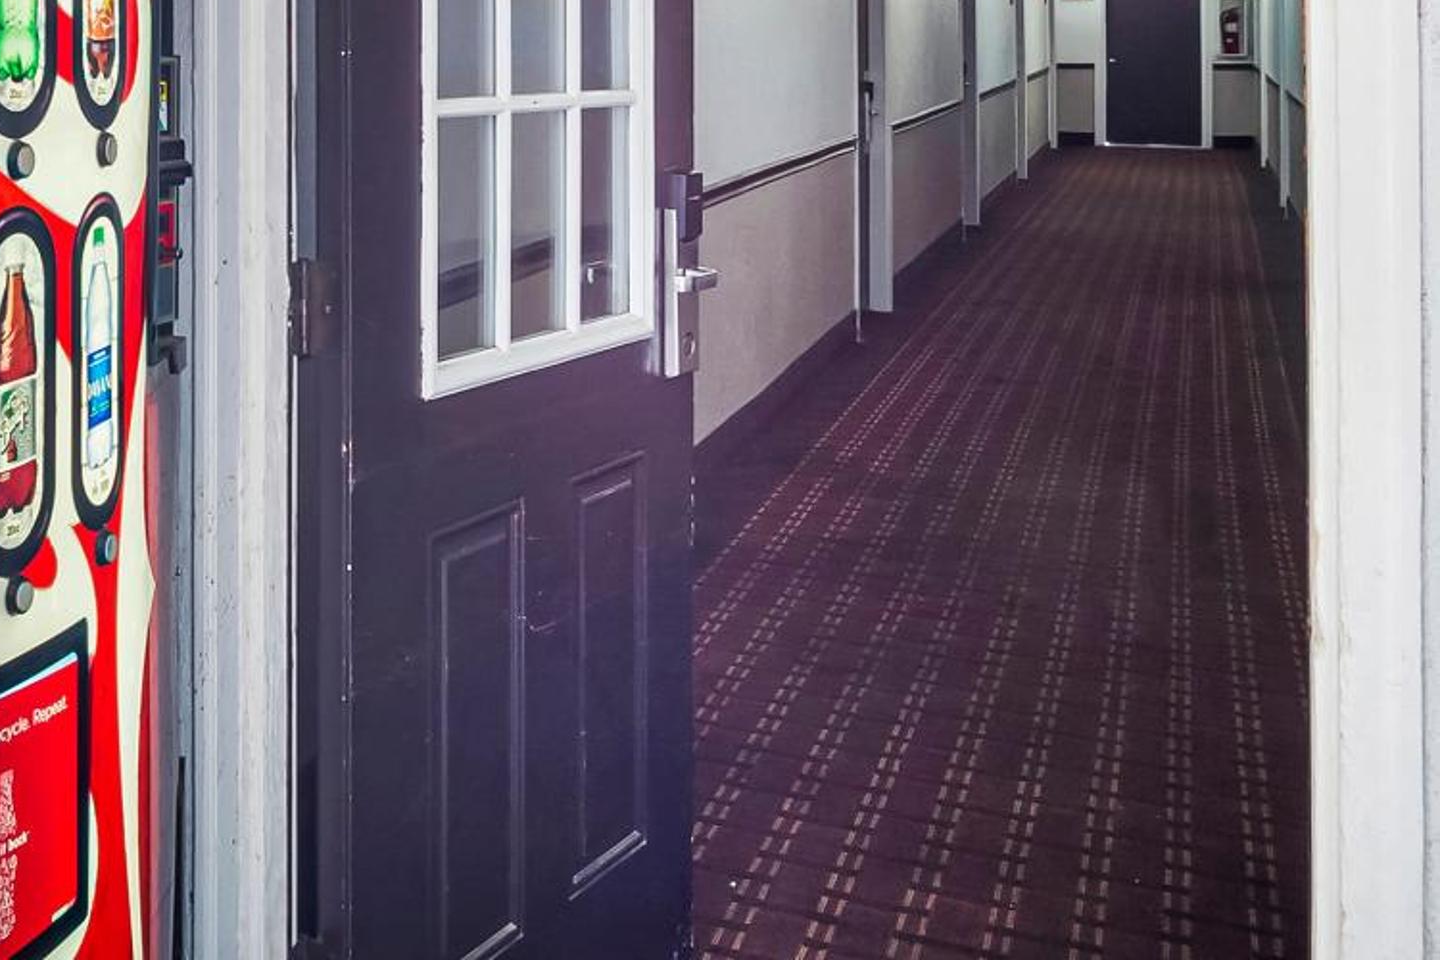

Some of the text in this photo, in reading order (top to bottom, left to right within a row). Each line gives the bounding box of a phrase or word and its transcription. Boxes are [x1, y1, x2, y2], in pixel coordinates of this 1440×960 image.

[32, 695, 68, 726] Repeat.
[0, 842, 7, 856] it
[7, 831, 28, 851] back
